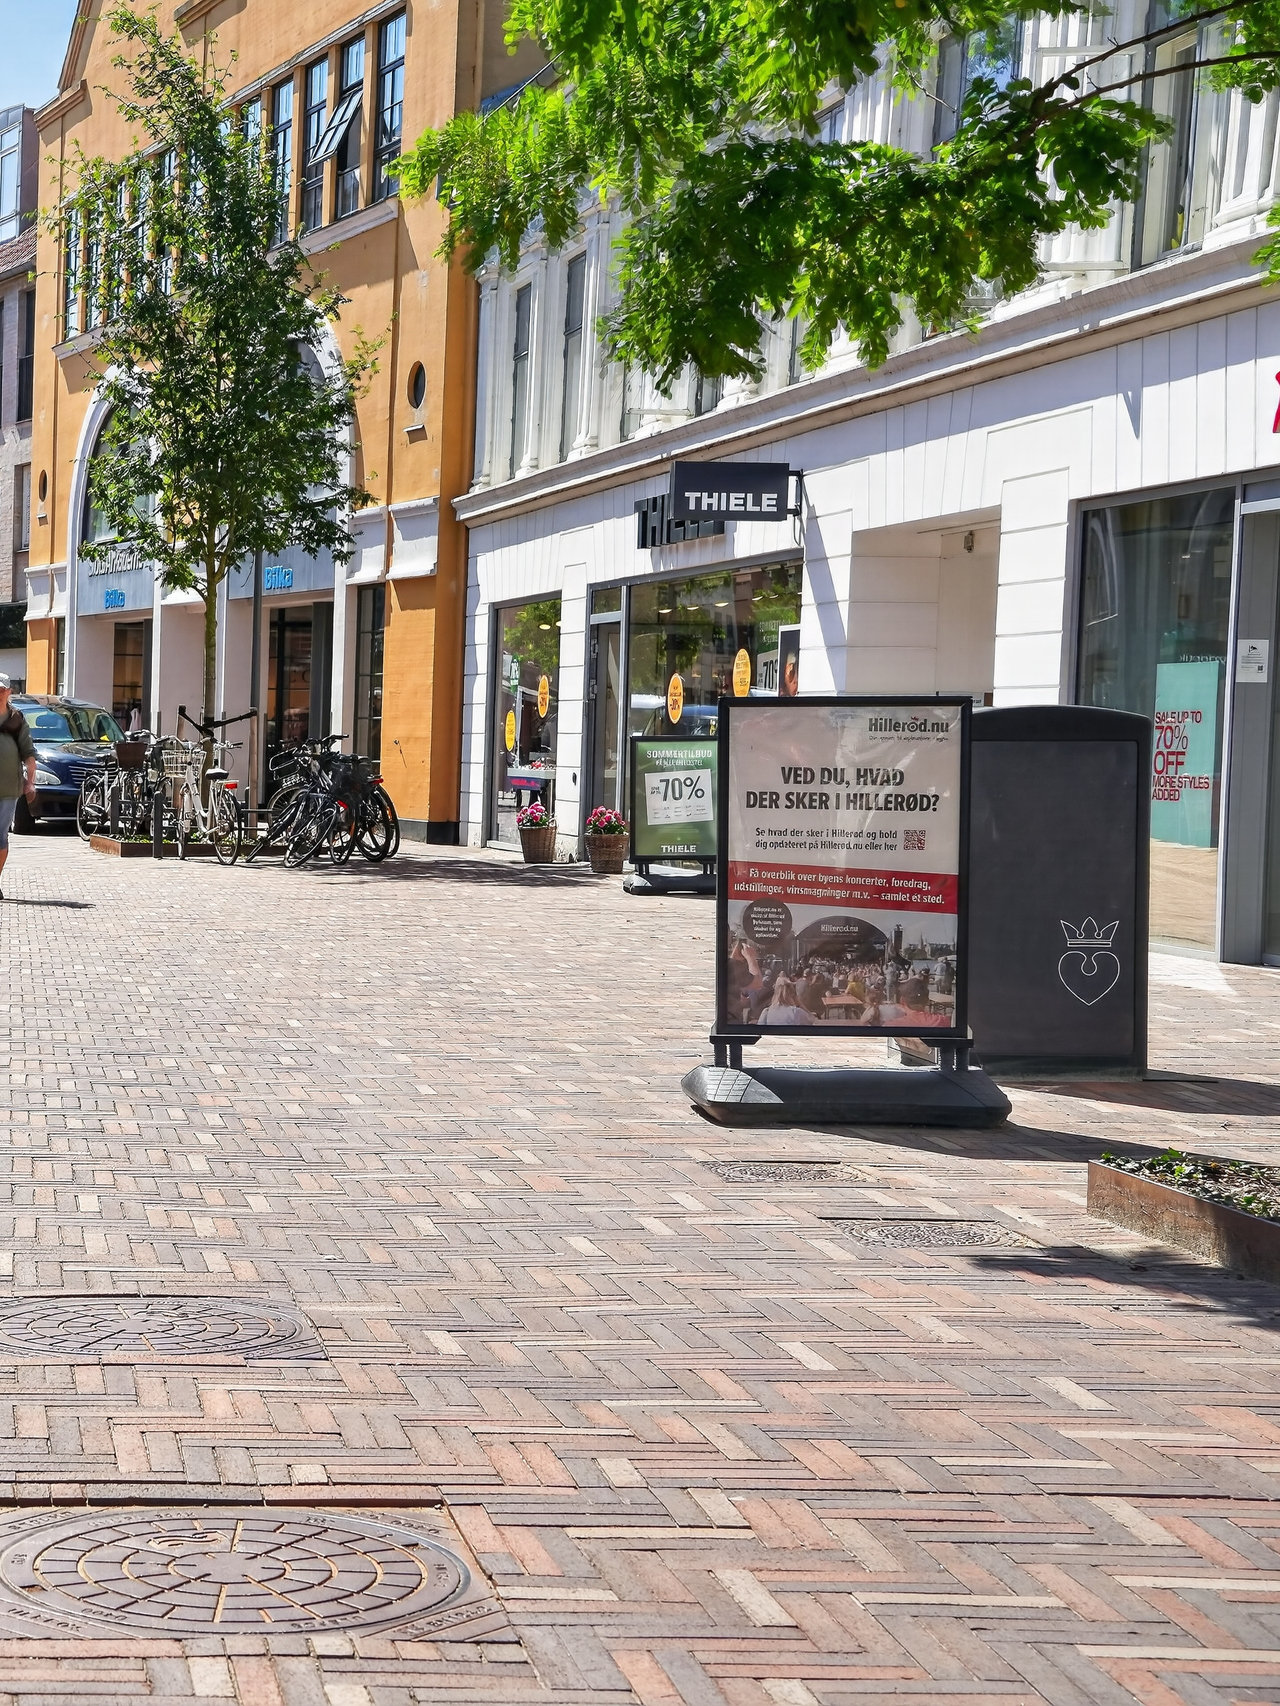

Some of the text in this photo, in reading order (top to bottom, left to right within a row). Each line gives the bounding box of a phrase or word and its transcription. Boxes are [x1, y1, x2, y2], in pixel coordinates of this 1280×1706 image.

[684, 492, 778, 512] THIELE
[265, 566, 293, 590] Bilka
[1155, 711, 1203, 724] SALE UP TO
[1155, 725, 1188, 750] 70%
[1153, 751, 1186, 775] OFF
[781, 767, 905, 788] VED DU, HVAD
[1152, 775, 1210, 789] MORE STYLES
[660, 776, 705, 802] 70%
[1152, 789, 1180, 801] ADDED
[746, 791, 940, 812] DER SKER I HILLERØD?
[756, 828, 766, 836] Se
[768, 828, 788, 837] hvad
[790, 829, 803, 837] der
[806, 829, 823, 837] sker
[867, 831, 877, 840] og
[879, 830, 898, 839] hold
[661, 845, 697, 853] THIELE
[756, 840, 767, 850] dig
[769, 841, 807, 850] opdateret
[809, 840, 819, 850] på
[865, 841, 882, 850] eller
[884, 841, 898, 850] her
[750, 868, 932, 891] Få overblik over byens koncerter, foredrag,
[734, 881, 785, 895] udstillinger,
[787, 885, 851, 899] vinsmagninger
[881, 891, 910, 902] samlet
[912, 892, 921, 902] ét
[923, 893, 945, 904] sted.
